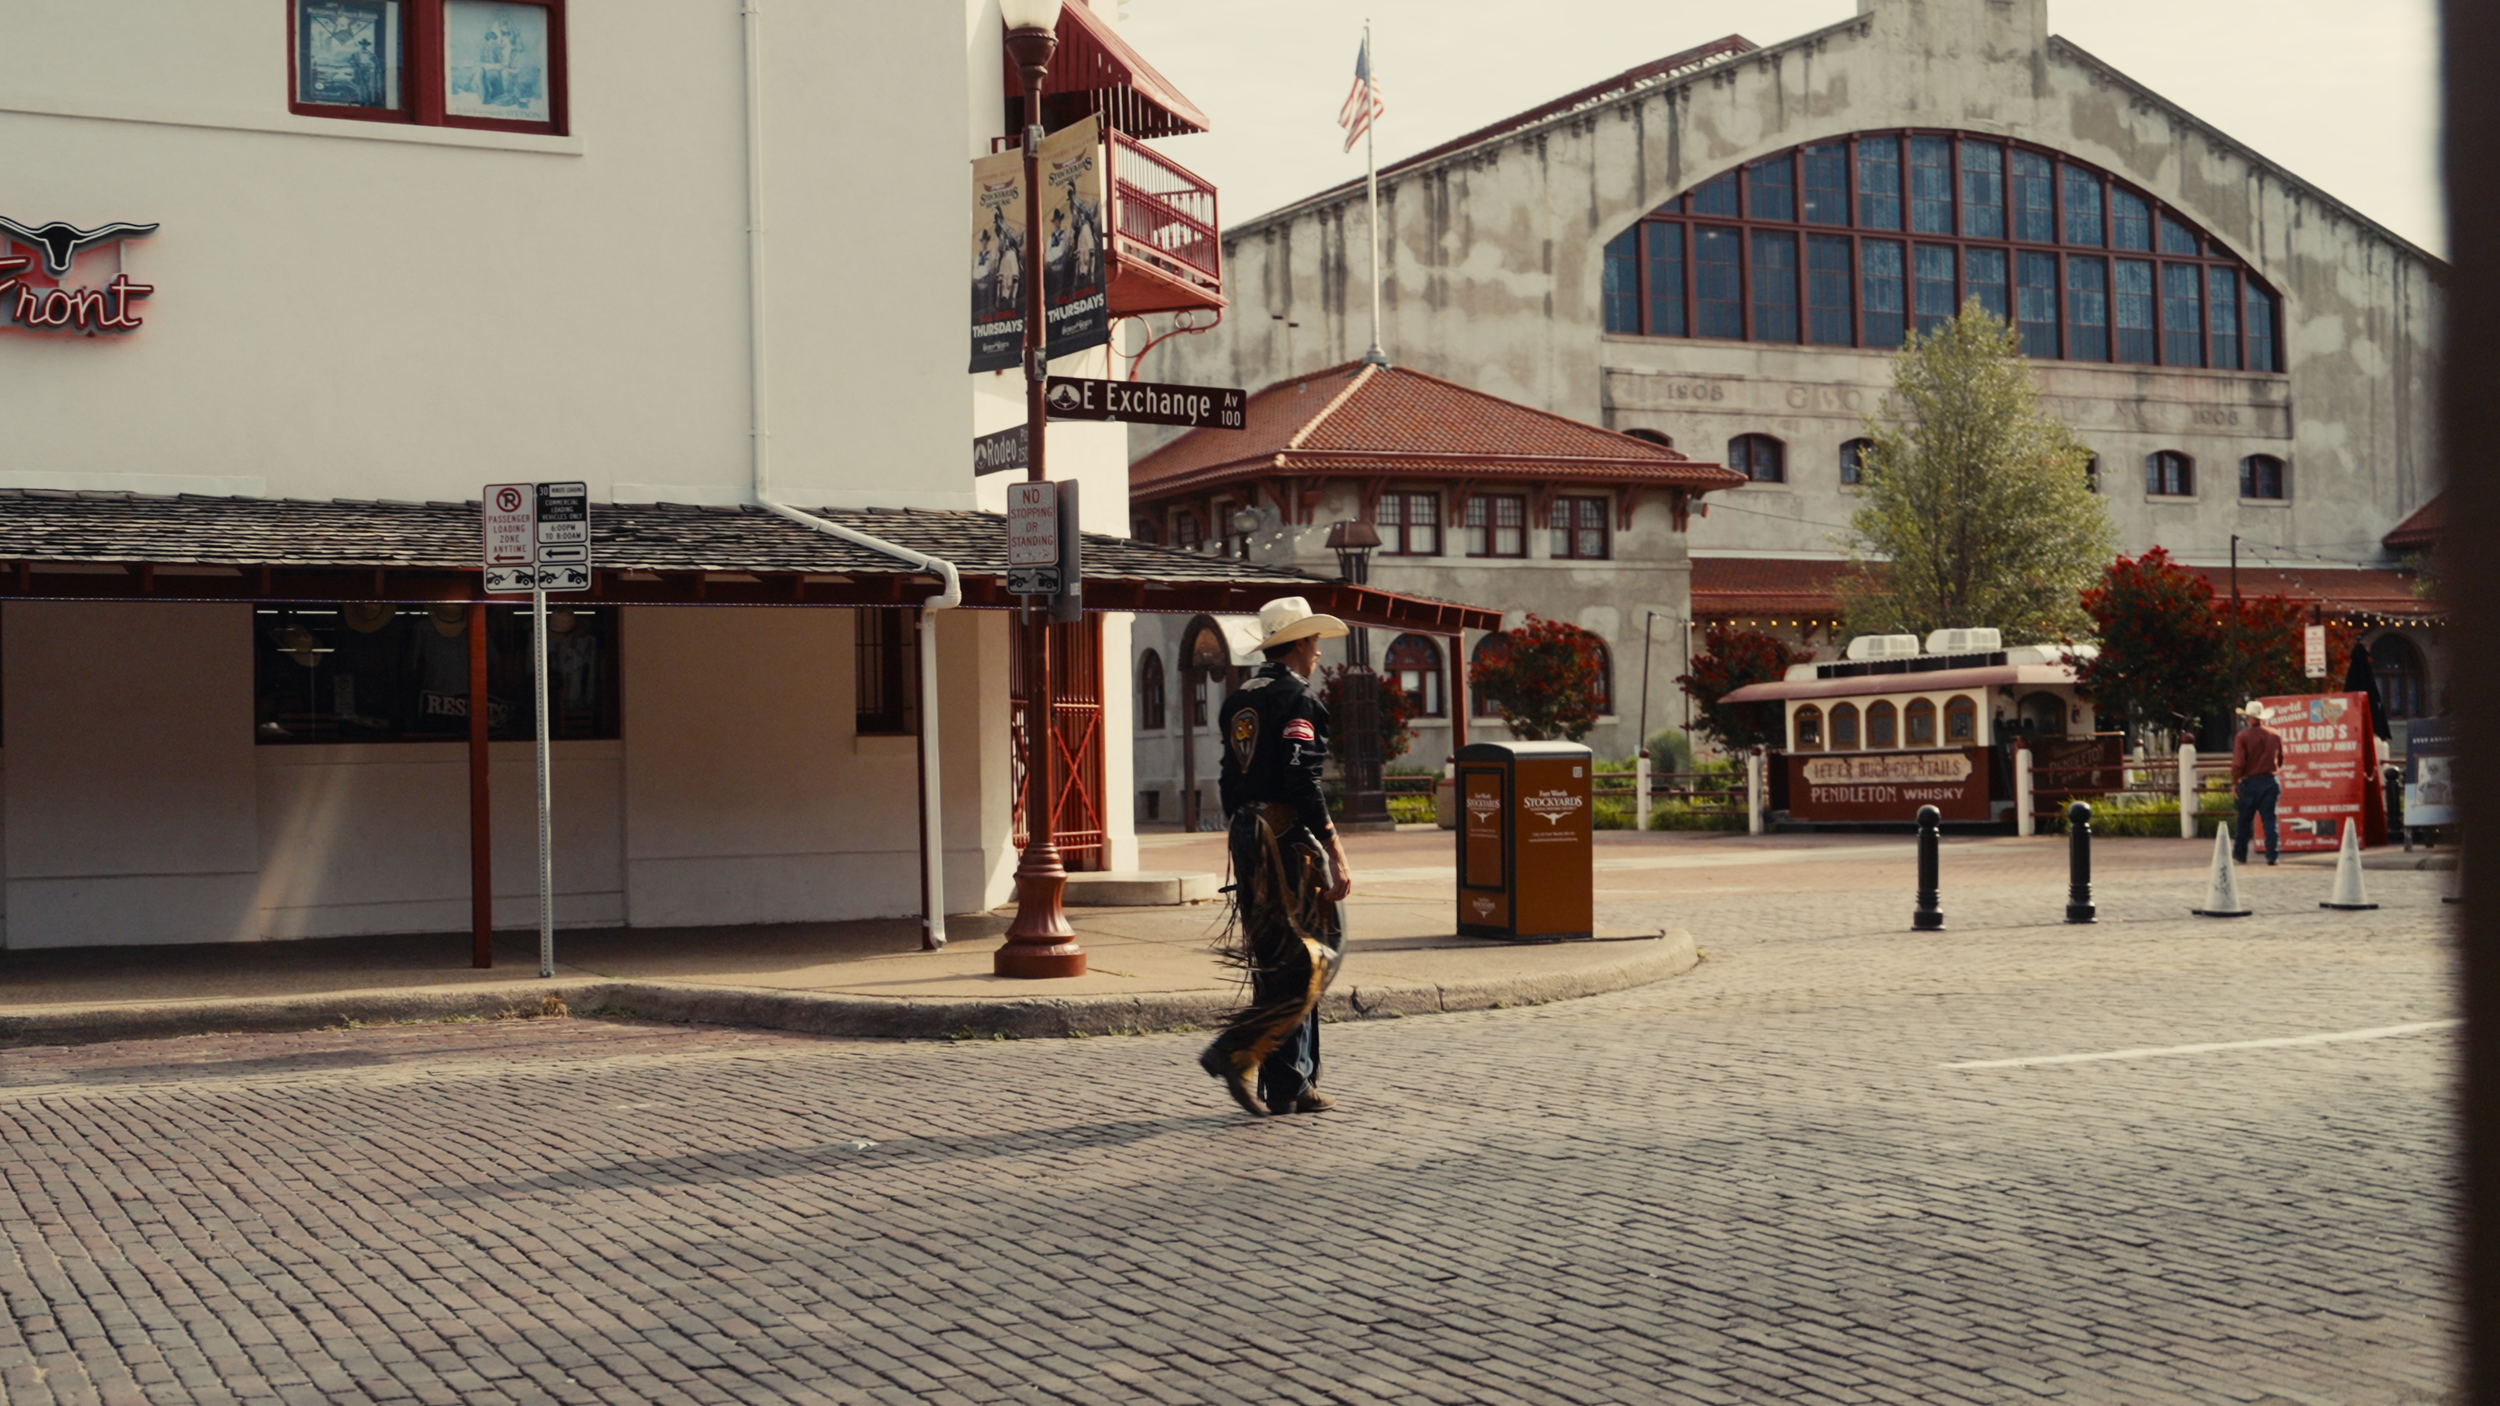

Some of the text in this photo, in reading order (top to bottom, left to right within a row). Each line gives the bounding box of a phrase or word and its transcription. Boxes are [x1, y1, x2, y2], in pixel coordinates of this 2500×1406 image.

[1048, 157, 1093, 187] STOCKYARDS
[1047, 293, 1105, 323] THURSDAYS
[972, 319, 1024, 338] THURSDAYS
[1083, 381, 1211, 425] E Exchange
[1223, 392, 1239, 408] Av
[1221, 410, 1241, 427] 100
[986, 435, 1018, 467] Rodeo
[539, 486, 549, 496] 30
[1022, 488, 1040, 504] NO
[545, 498, 579, 507] COMMERCIAL
[488, 514, 531, 524] PASSENGER
[1010, 507, 1054, 520] STOPPING
[493, 524, 526, 534] LOADING
[551, 524, 576, 532] 6:00PM
[1025, 522, 1038, 533] OR
[499, 535, 520, 544] ZONE
[545, 532, 582, 541] TO 8:00AM
[1011, 535, 1054, 548] STANDING
[493, 544, 527, 553] ANYTIME
[2280, 724, 2348, 742] ILLY BOB'S
[2290, 743, 2311, 753] TWO
[2311, 742, 2332, 752] STEP
[2334, 741, 2358, 751] AWAY
[1858, 761, 1889, 778] BUCK
[1894, 759, 1961, 777] COCKTAILS
[2308, 761, 2355, 769] Restaurant
[2283, 770, 2355, 780] Music Dancing
[2302, 780, 2332, 790] Riding
[1539, 789, 1568, 797] Fort Worth
[1810, 786, 1964, 804] PENDLETON WHISKY
[1466, 798, 1500, 808] STOCKYARDS
[1523, 795, 1583, 808] STOCKYARDS
[2329, 803, 2361, 812] WELCOME
